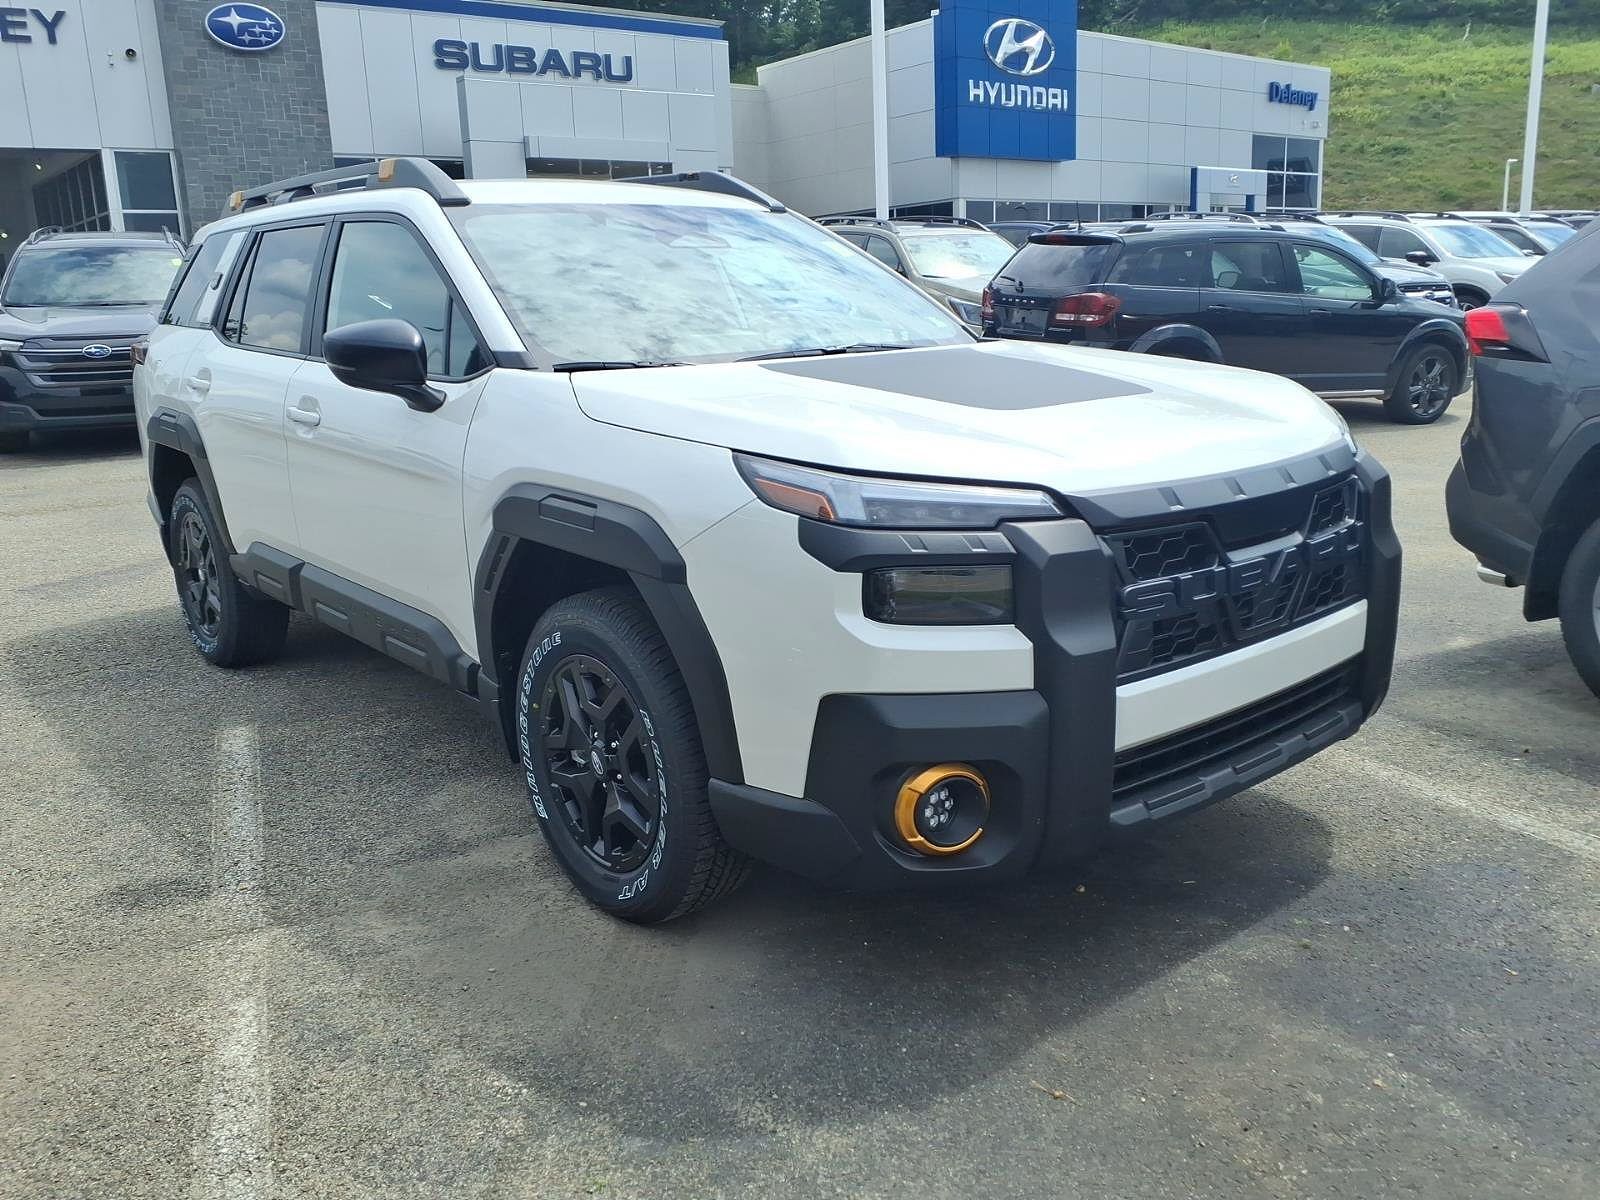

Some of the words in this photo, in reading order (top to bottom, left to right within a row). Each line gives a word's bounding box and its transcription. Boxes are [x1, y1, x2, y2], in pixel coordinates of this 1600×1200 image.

[0, 7, 66, 45] EY
[434, 38, 634, 82] SUBARU
[968, 79, 1068, 112] HYUNDAI
[1269, 81, 1318, 111] Delaney
[518, 632, 562, 819] BRIDGESTONE
[618, 870, 649, 900] A/T
